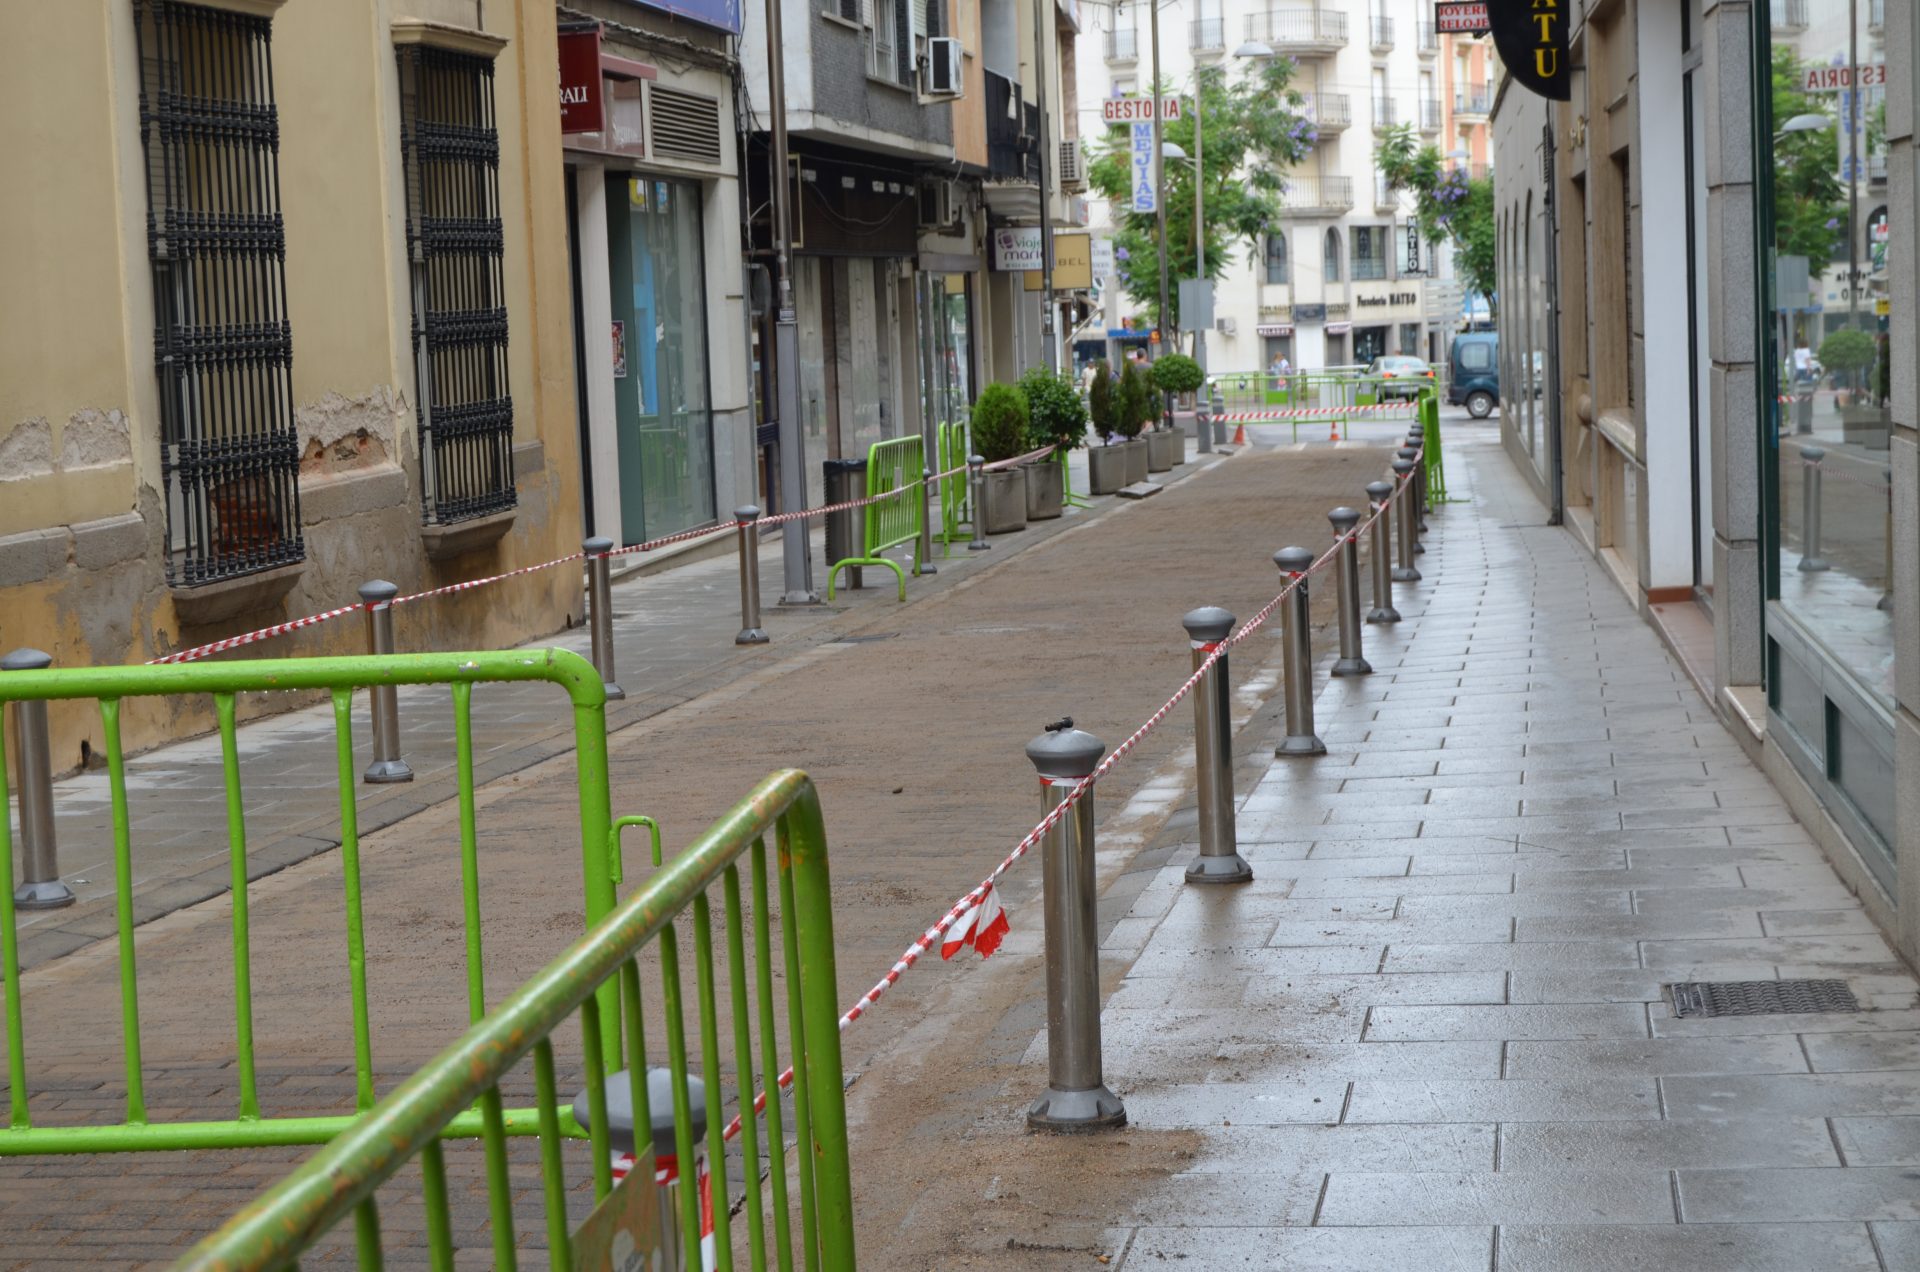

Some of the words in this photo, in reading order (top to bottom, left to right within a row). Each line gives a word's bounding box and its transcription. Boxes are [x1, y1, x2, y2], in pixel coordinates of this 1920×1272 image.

[1105, 99, 1179, 119] GESTOIA
[1133, 123, 1154, 211] MEJIAS
[1408, 216, 1418, 270] MATEO
